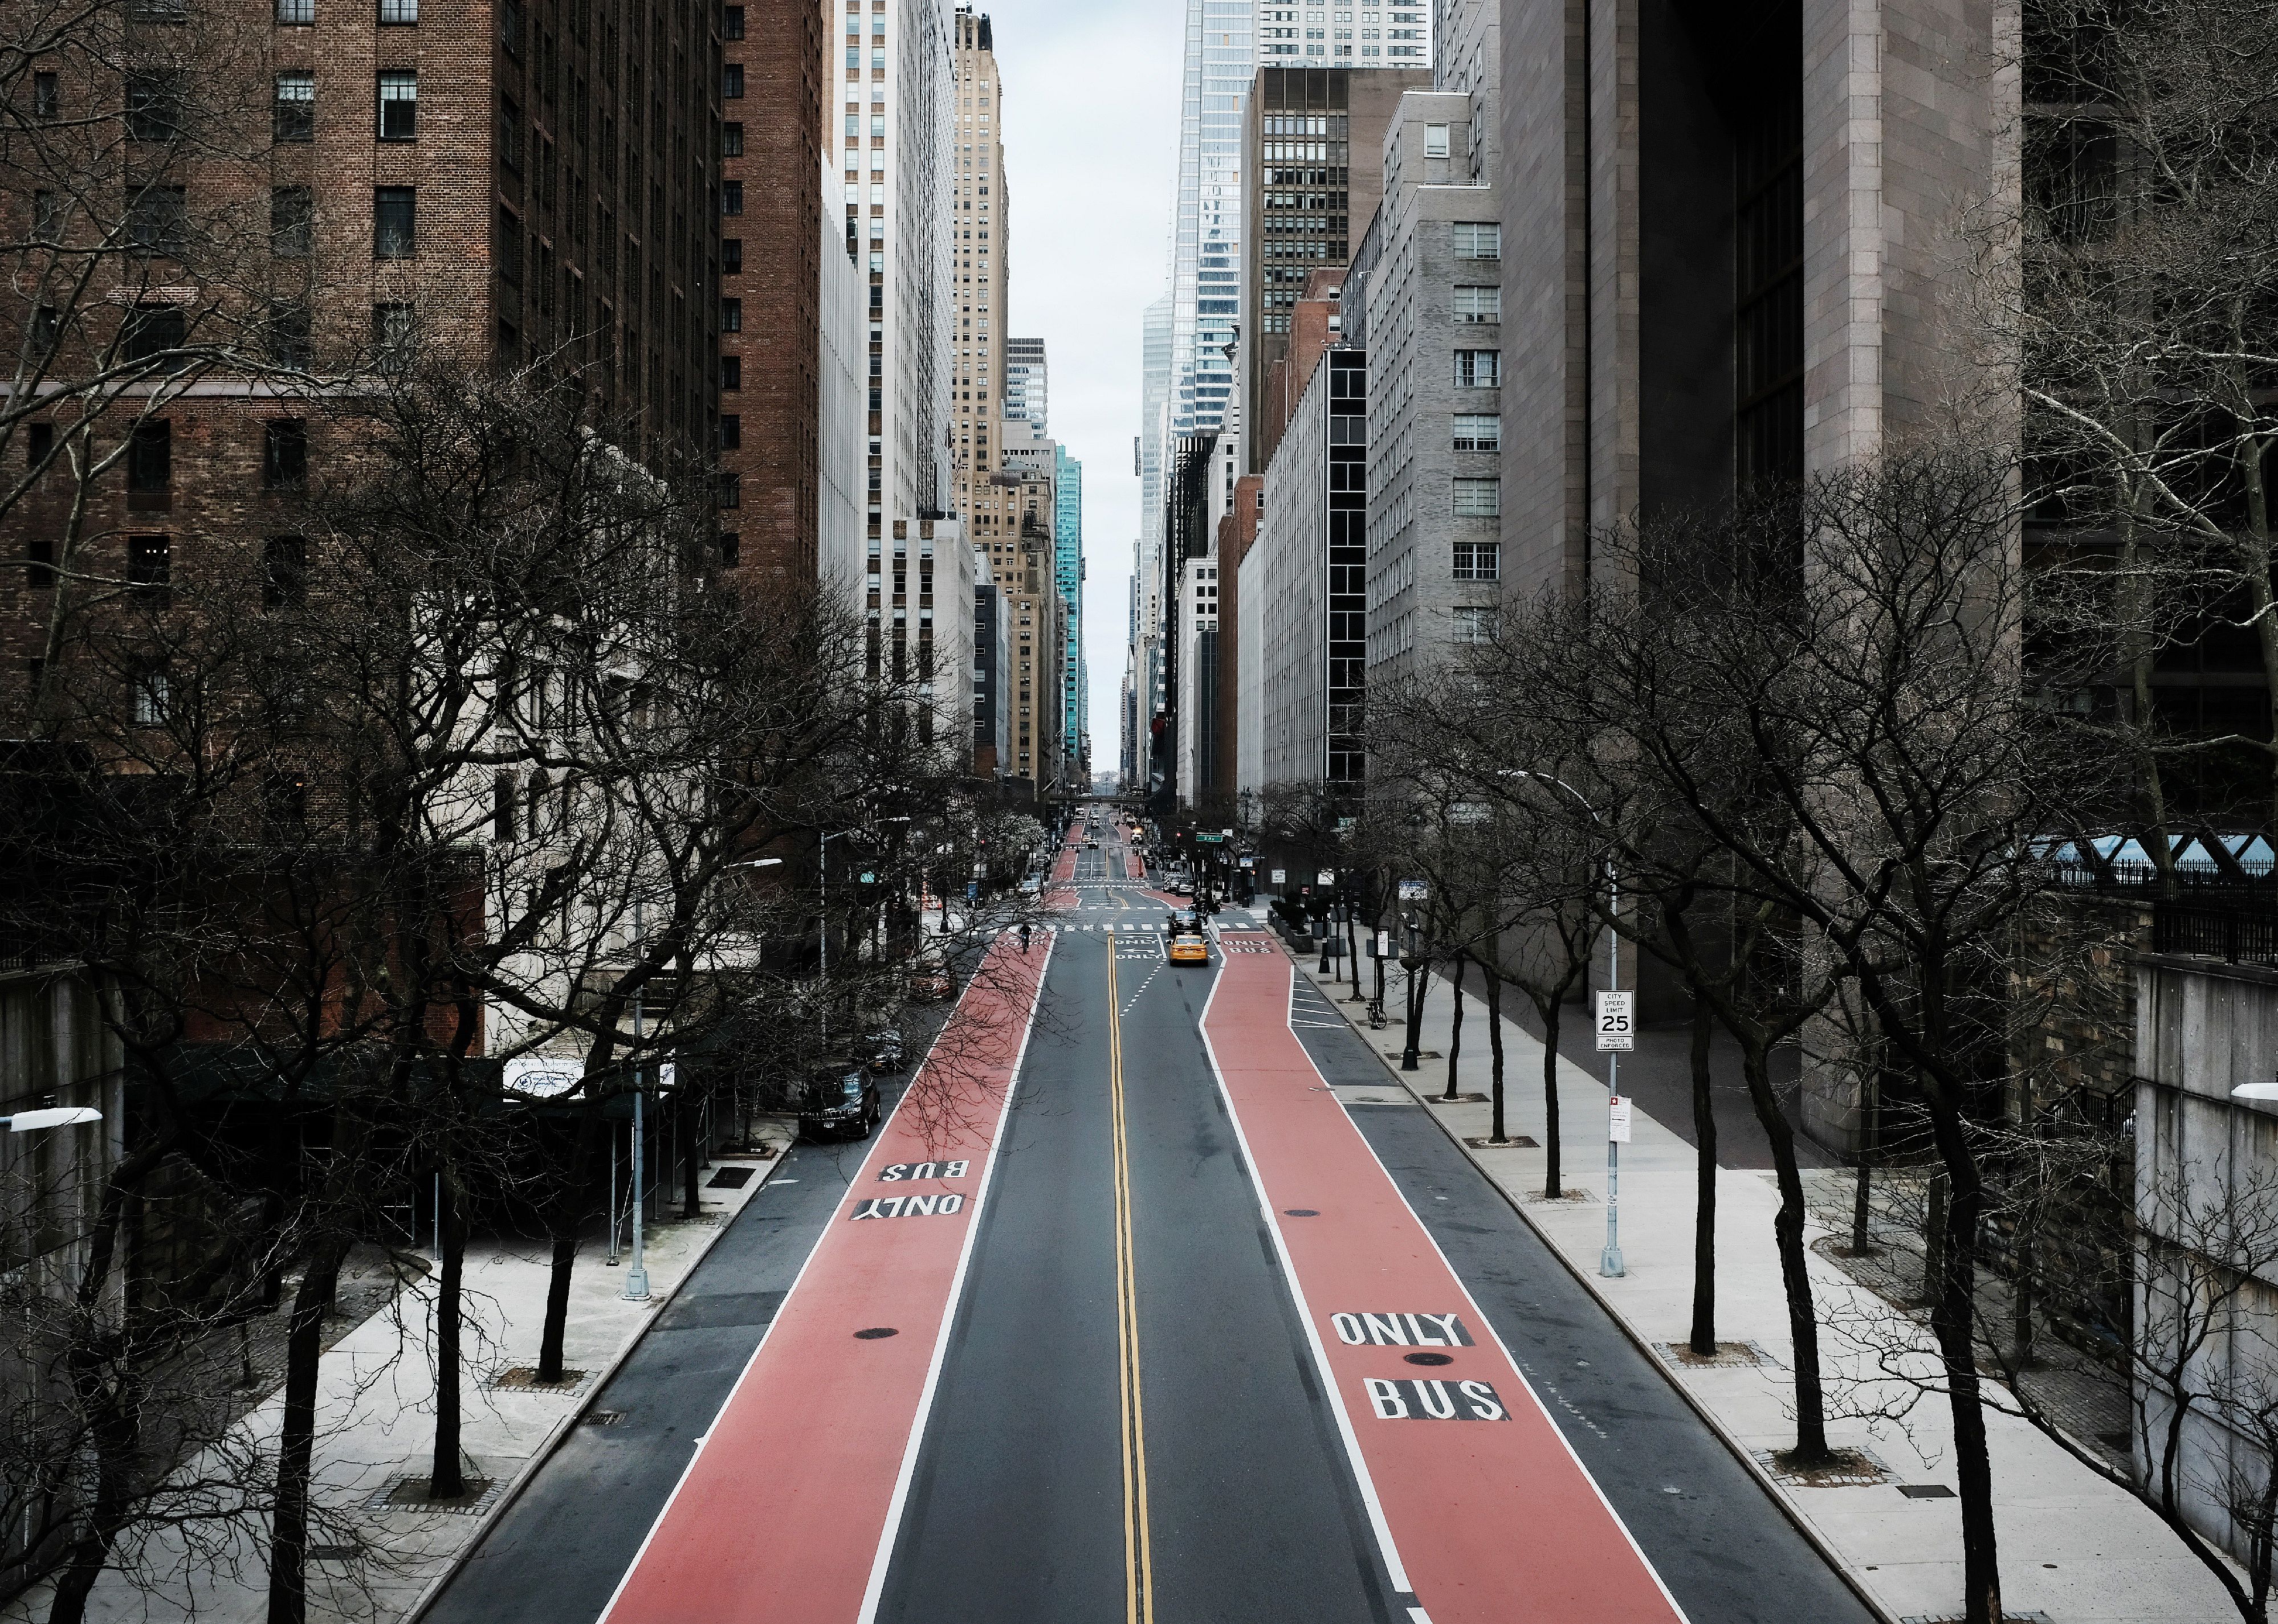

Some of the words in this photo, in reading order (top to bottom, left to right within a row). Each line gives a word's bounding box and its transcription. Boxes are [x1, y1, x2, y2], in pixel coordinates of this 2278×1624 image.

[1602, 1015, 1629, 1031] 25
[882, 1160, 970, 1182] BUS
[851, 1194, 963, 1221] ONLY
[1330, 1312, 1463, 1346] ONLY
[1363, 1378, 1503, 1421] BUS
